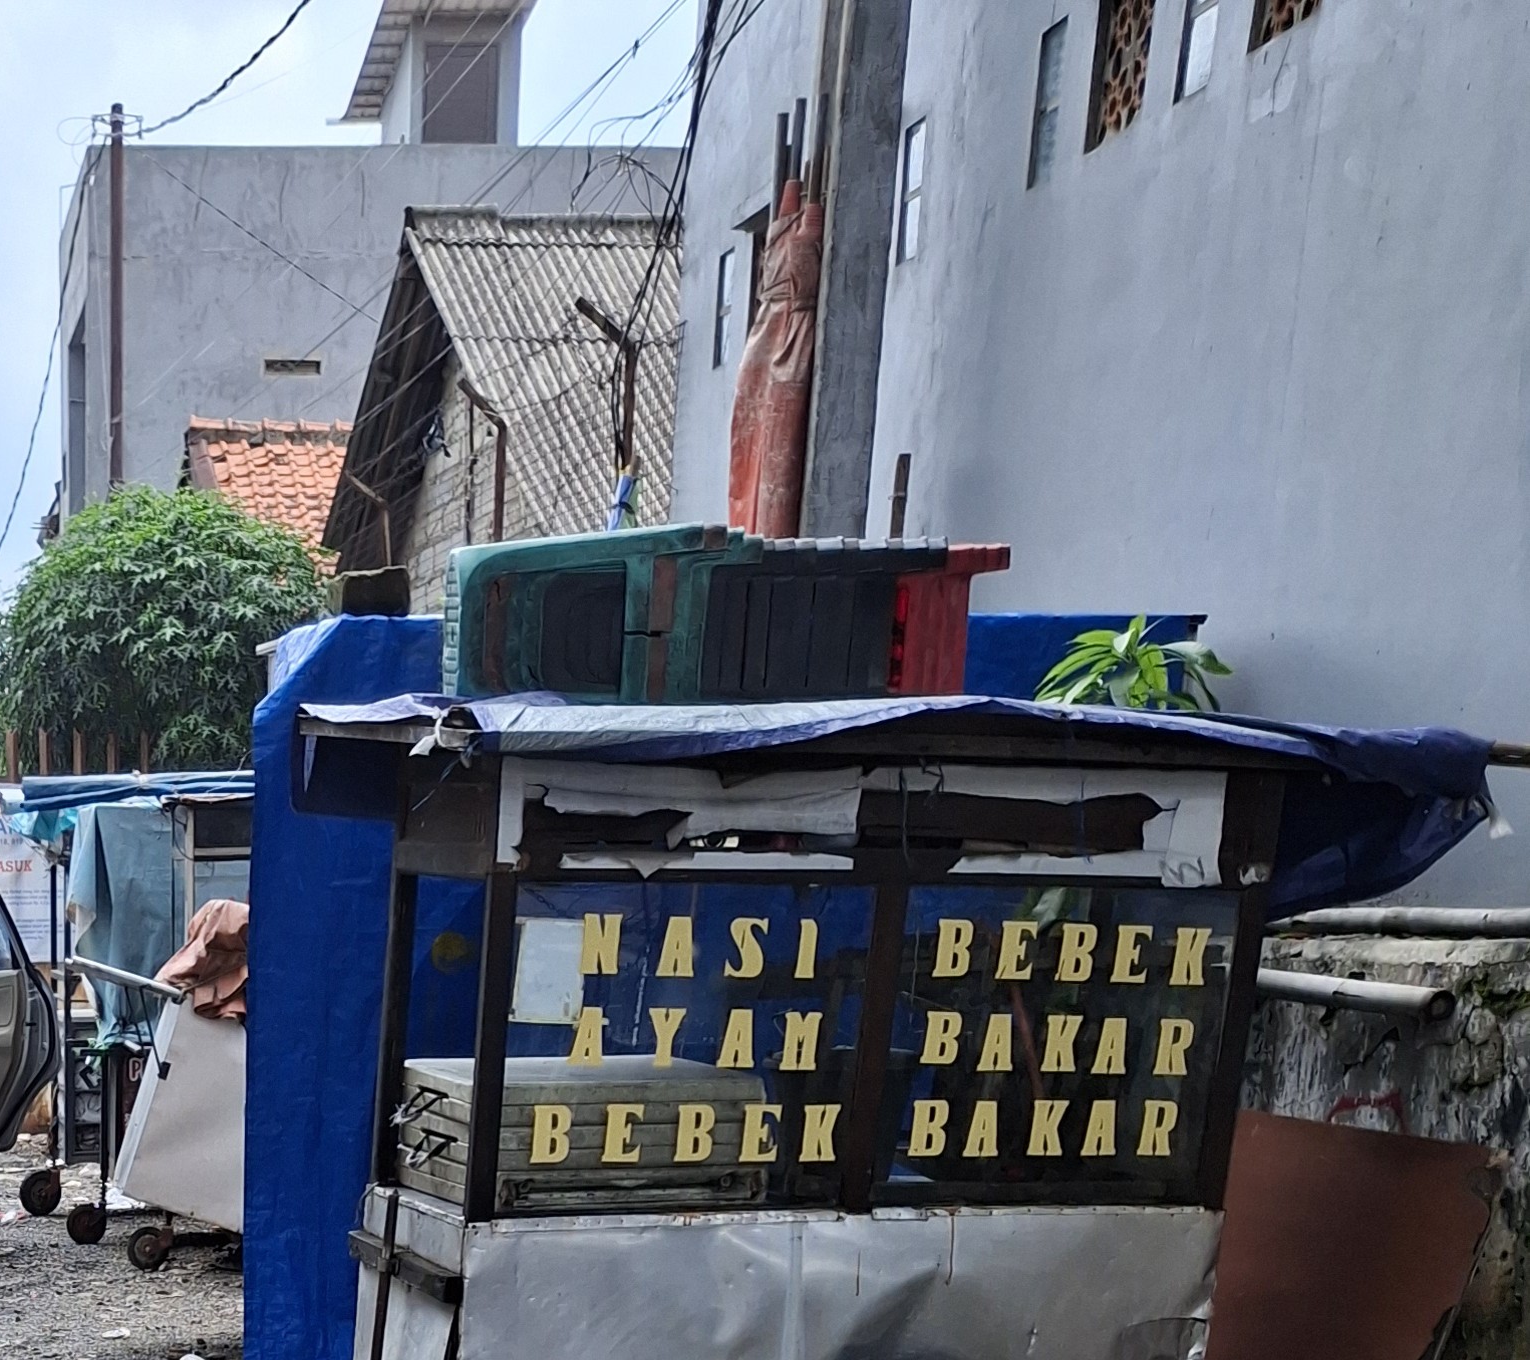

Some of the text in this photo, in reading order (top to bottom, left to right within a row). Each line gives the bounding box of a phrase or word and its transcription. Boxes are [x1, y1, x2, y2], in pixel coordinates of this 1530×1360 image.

[581, 913, 1213, 987] NASI BEBEK
[567, 1006, 1196, 1077] AYAM BAKAR
[529, 1098, 1178, 1164] BEBEK BAKAR
